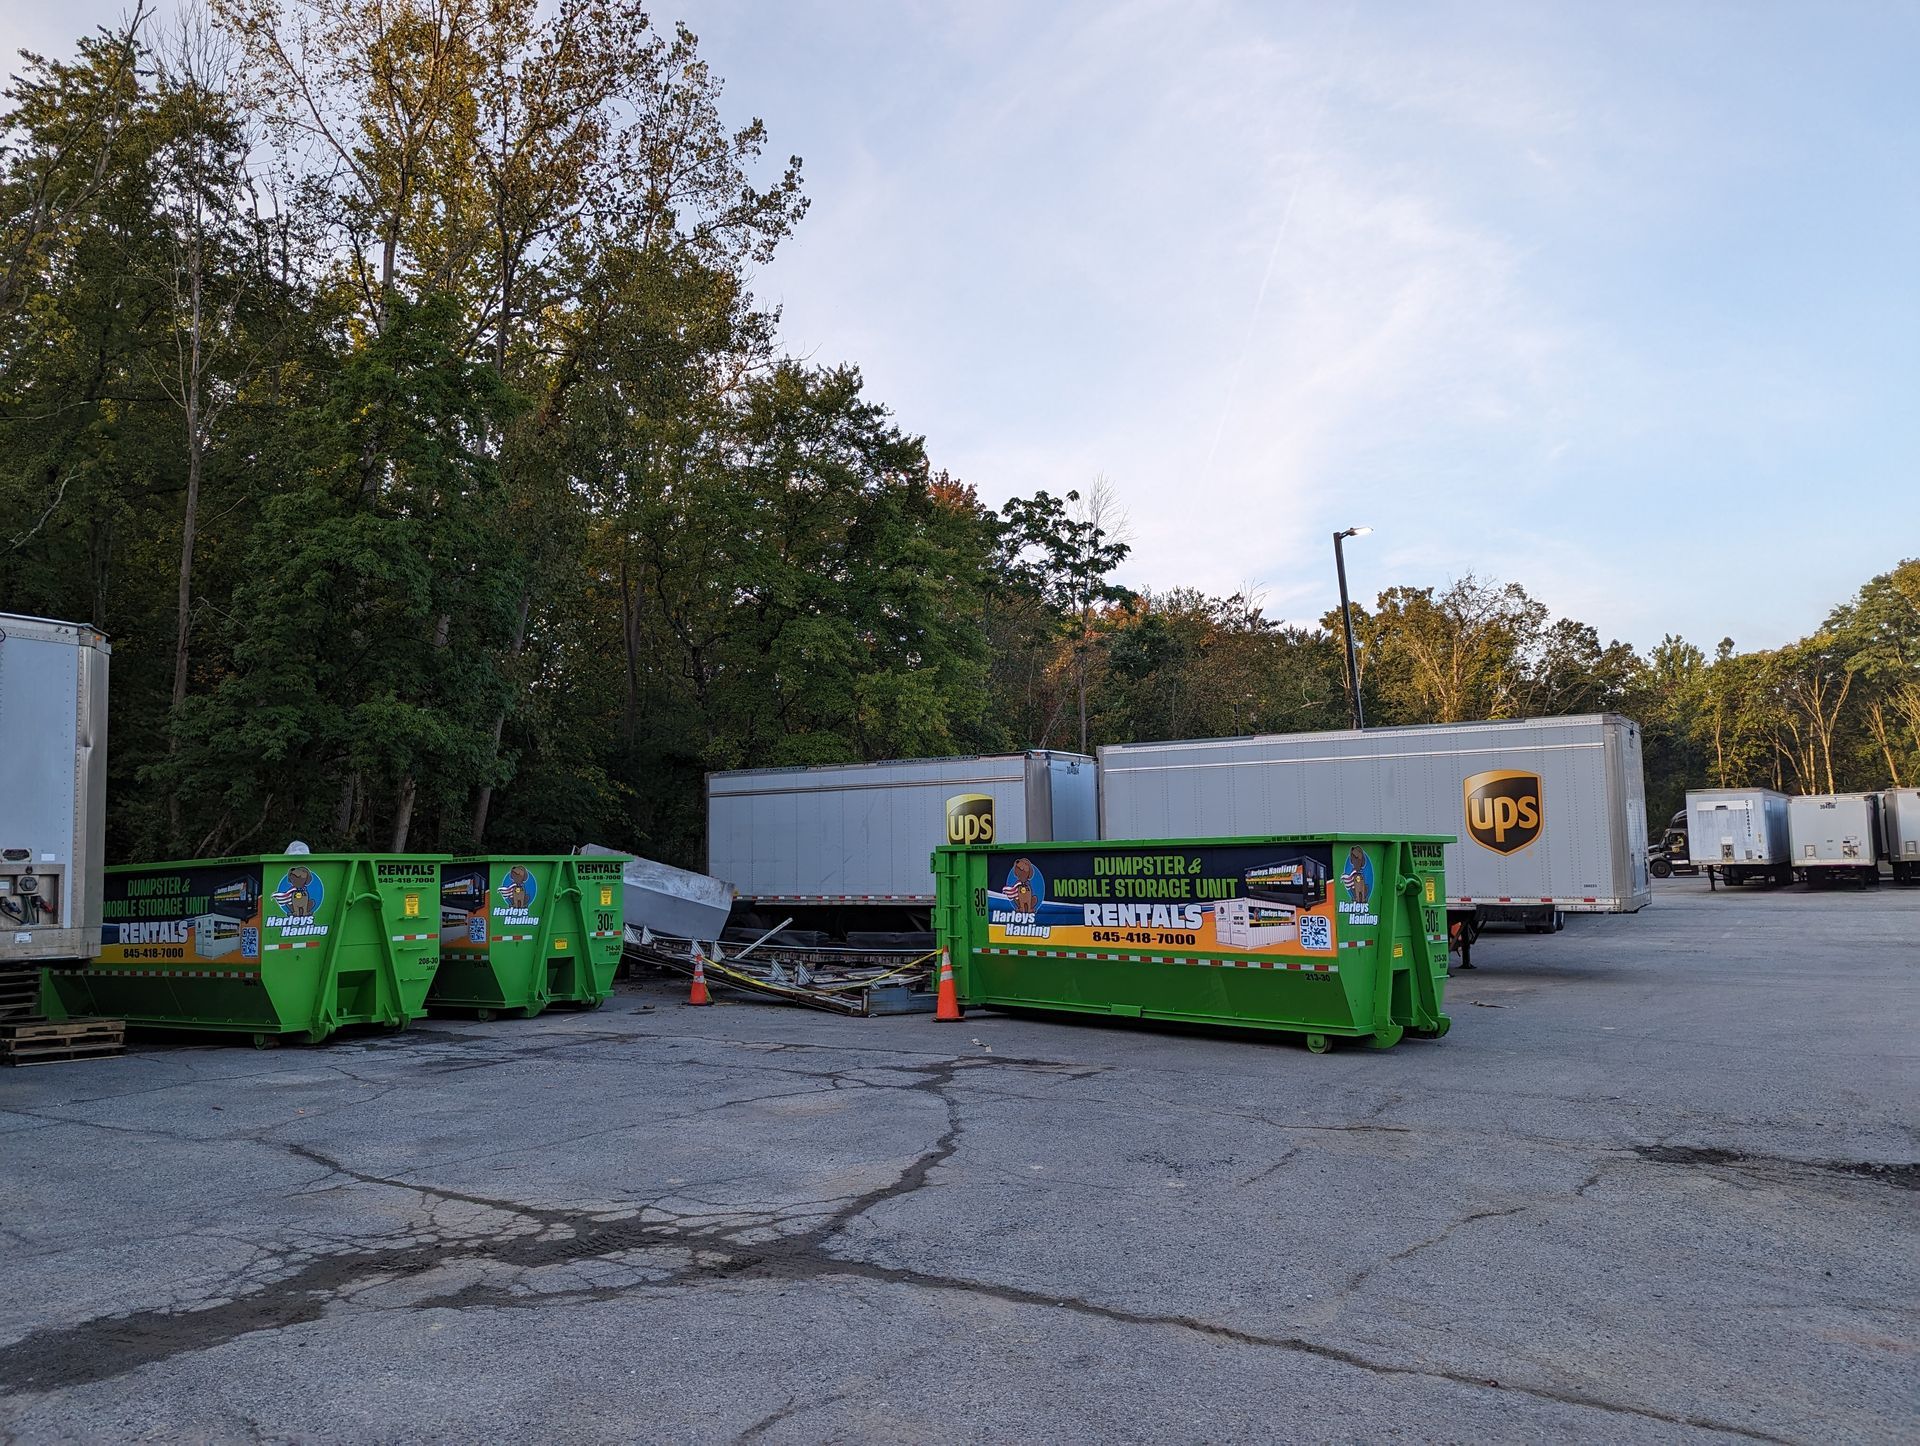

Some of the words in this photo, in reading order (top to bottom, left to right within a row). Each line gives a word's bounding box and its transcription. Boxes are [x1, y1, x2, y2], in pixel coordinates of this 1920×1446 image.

[1471, 796, 1538, 842] ups
[950, 814, 993, 844] ups
[1412, 845, 1441, 858] ENTALS
[378, 864, 435, 876] RENTALS
[577, 863, 621, 874] RENTALS
[1094, 856, 1185, 876] DUMPSTER
[1187, 857, 1202, 874] &
[128, 877, 181, 897] DUMPSTER
[182, 878, 191, 892] &
[1053, 879, 1111, 898] MOBILE
[1114, 878, 1191, 899] STORAGE
[1196, 878, 1239, 899] UNIT
[974, 888, 987, 908] 30
[103, 900, 138, 918] MOBILE
[138, 897, 184, 917] STORAGE
[185, 896, 210, 915] UNIT
[493, 907, 529, 918] Harleys
[976, 908, 986, 917] YD
[1338, 902, 1370, 914] Harleys
[266, 915, 315, 928] Harleys
[504, 915, 540, 926] Hauling
[597, 913, 610, 931] 30
[992, 910, 1036, 924] Harleys
[1083, 903, 1204, 930] RENTALS
[1349, 913, 1379, 926] Hauling
[1425, 910, 1436, 933] 30
[118, 920, 189, 944] RENTALS
[281, 924, 329, 937] Hauling
[1005, 923, 1051, 938] Hauling
[1092, 931, 1196, 946] 845-418-7000
[123, 947, 184, 959] 845-418-7000
[1305, 973, 1331, 983] 213-30
